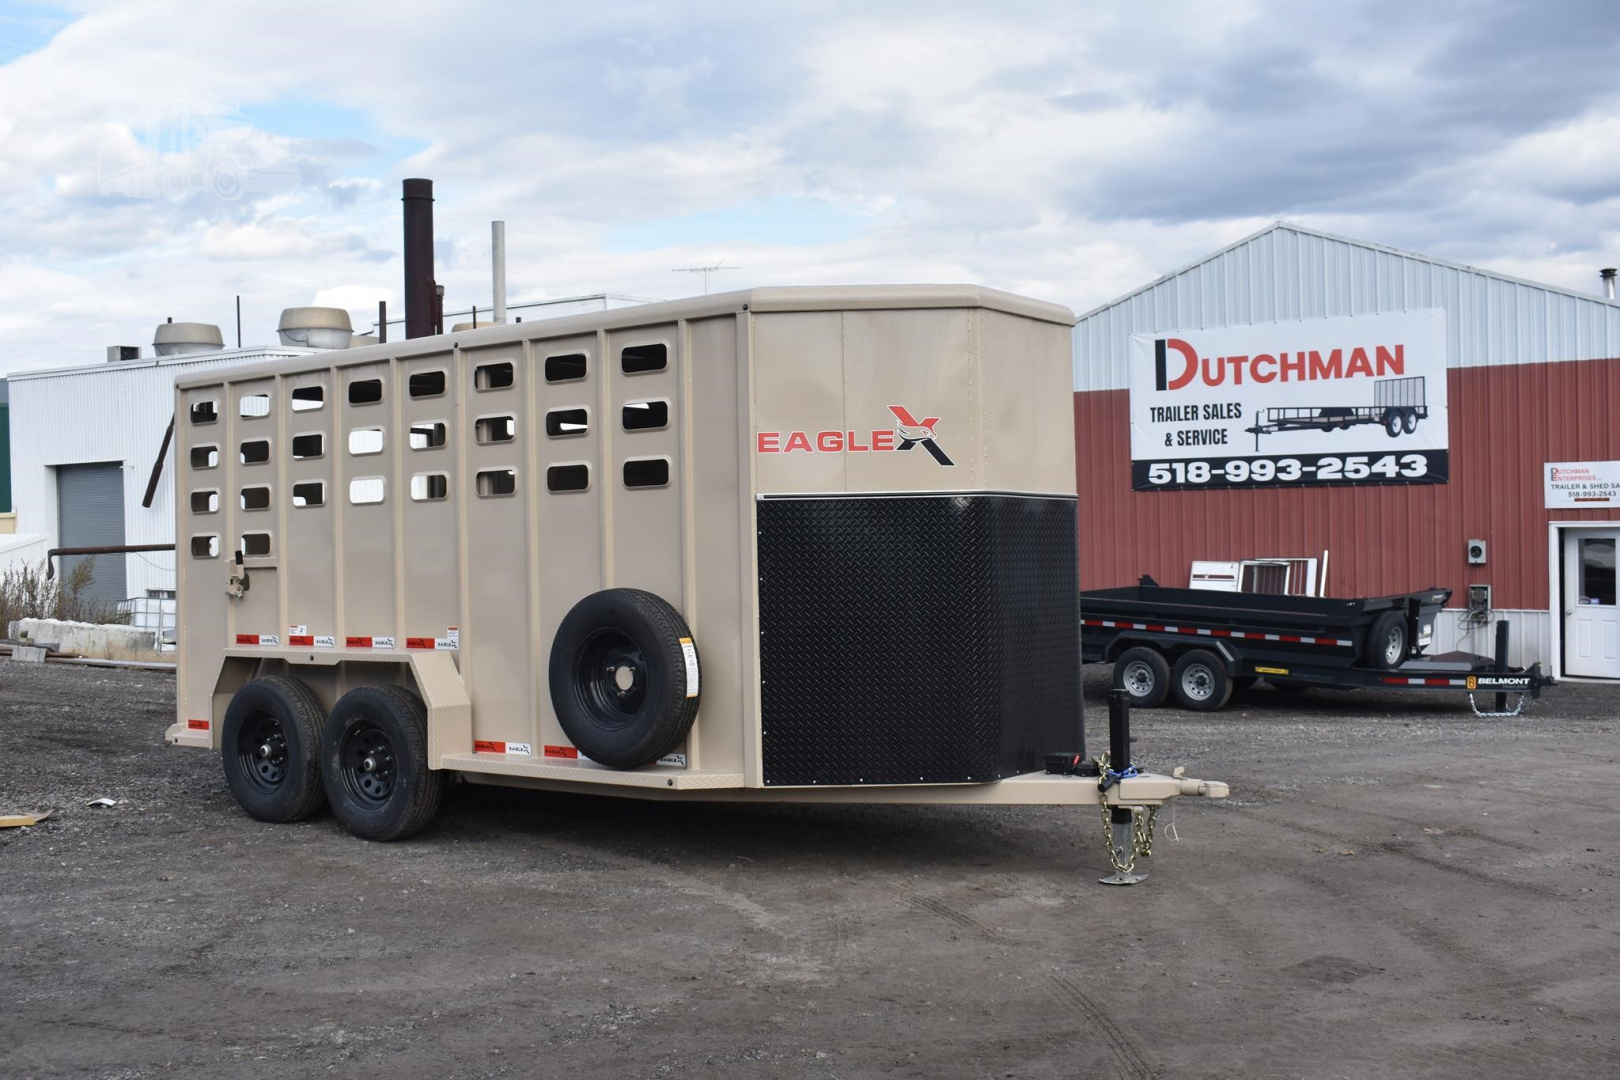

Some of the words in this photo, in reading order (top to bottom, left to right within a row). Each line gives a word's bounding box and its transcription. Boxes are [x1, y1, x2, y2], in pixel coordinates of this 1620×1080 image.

[1155, 338, 1404, 391] DUTCHMAN
[1150, 404, 1199, 422] TRAILER
[1203, 402, 1242, 420] SALES
[1164, 433, 1173, 447] &
[1177, 428, 1228, 446] SERVICE
[1148, 454, 1428, 484] 518-993-2543
[1478, 677, 1530, 685] BELMONT
